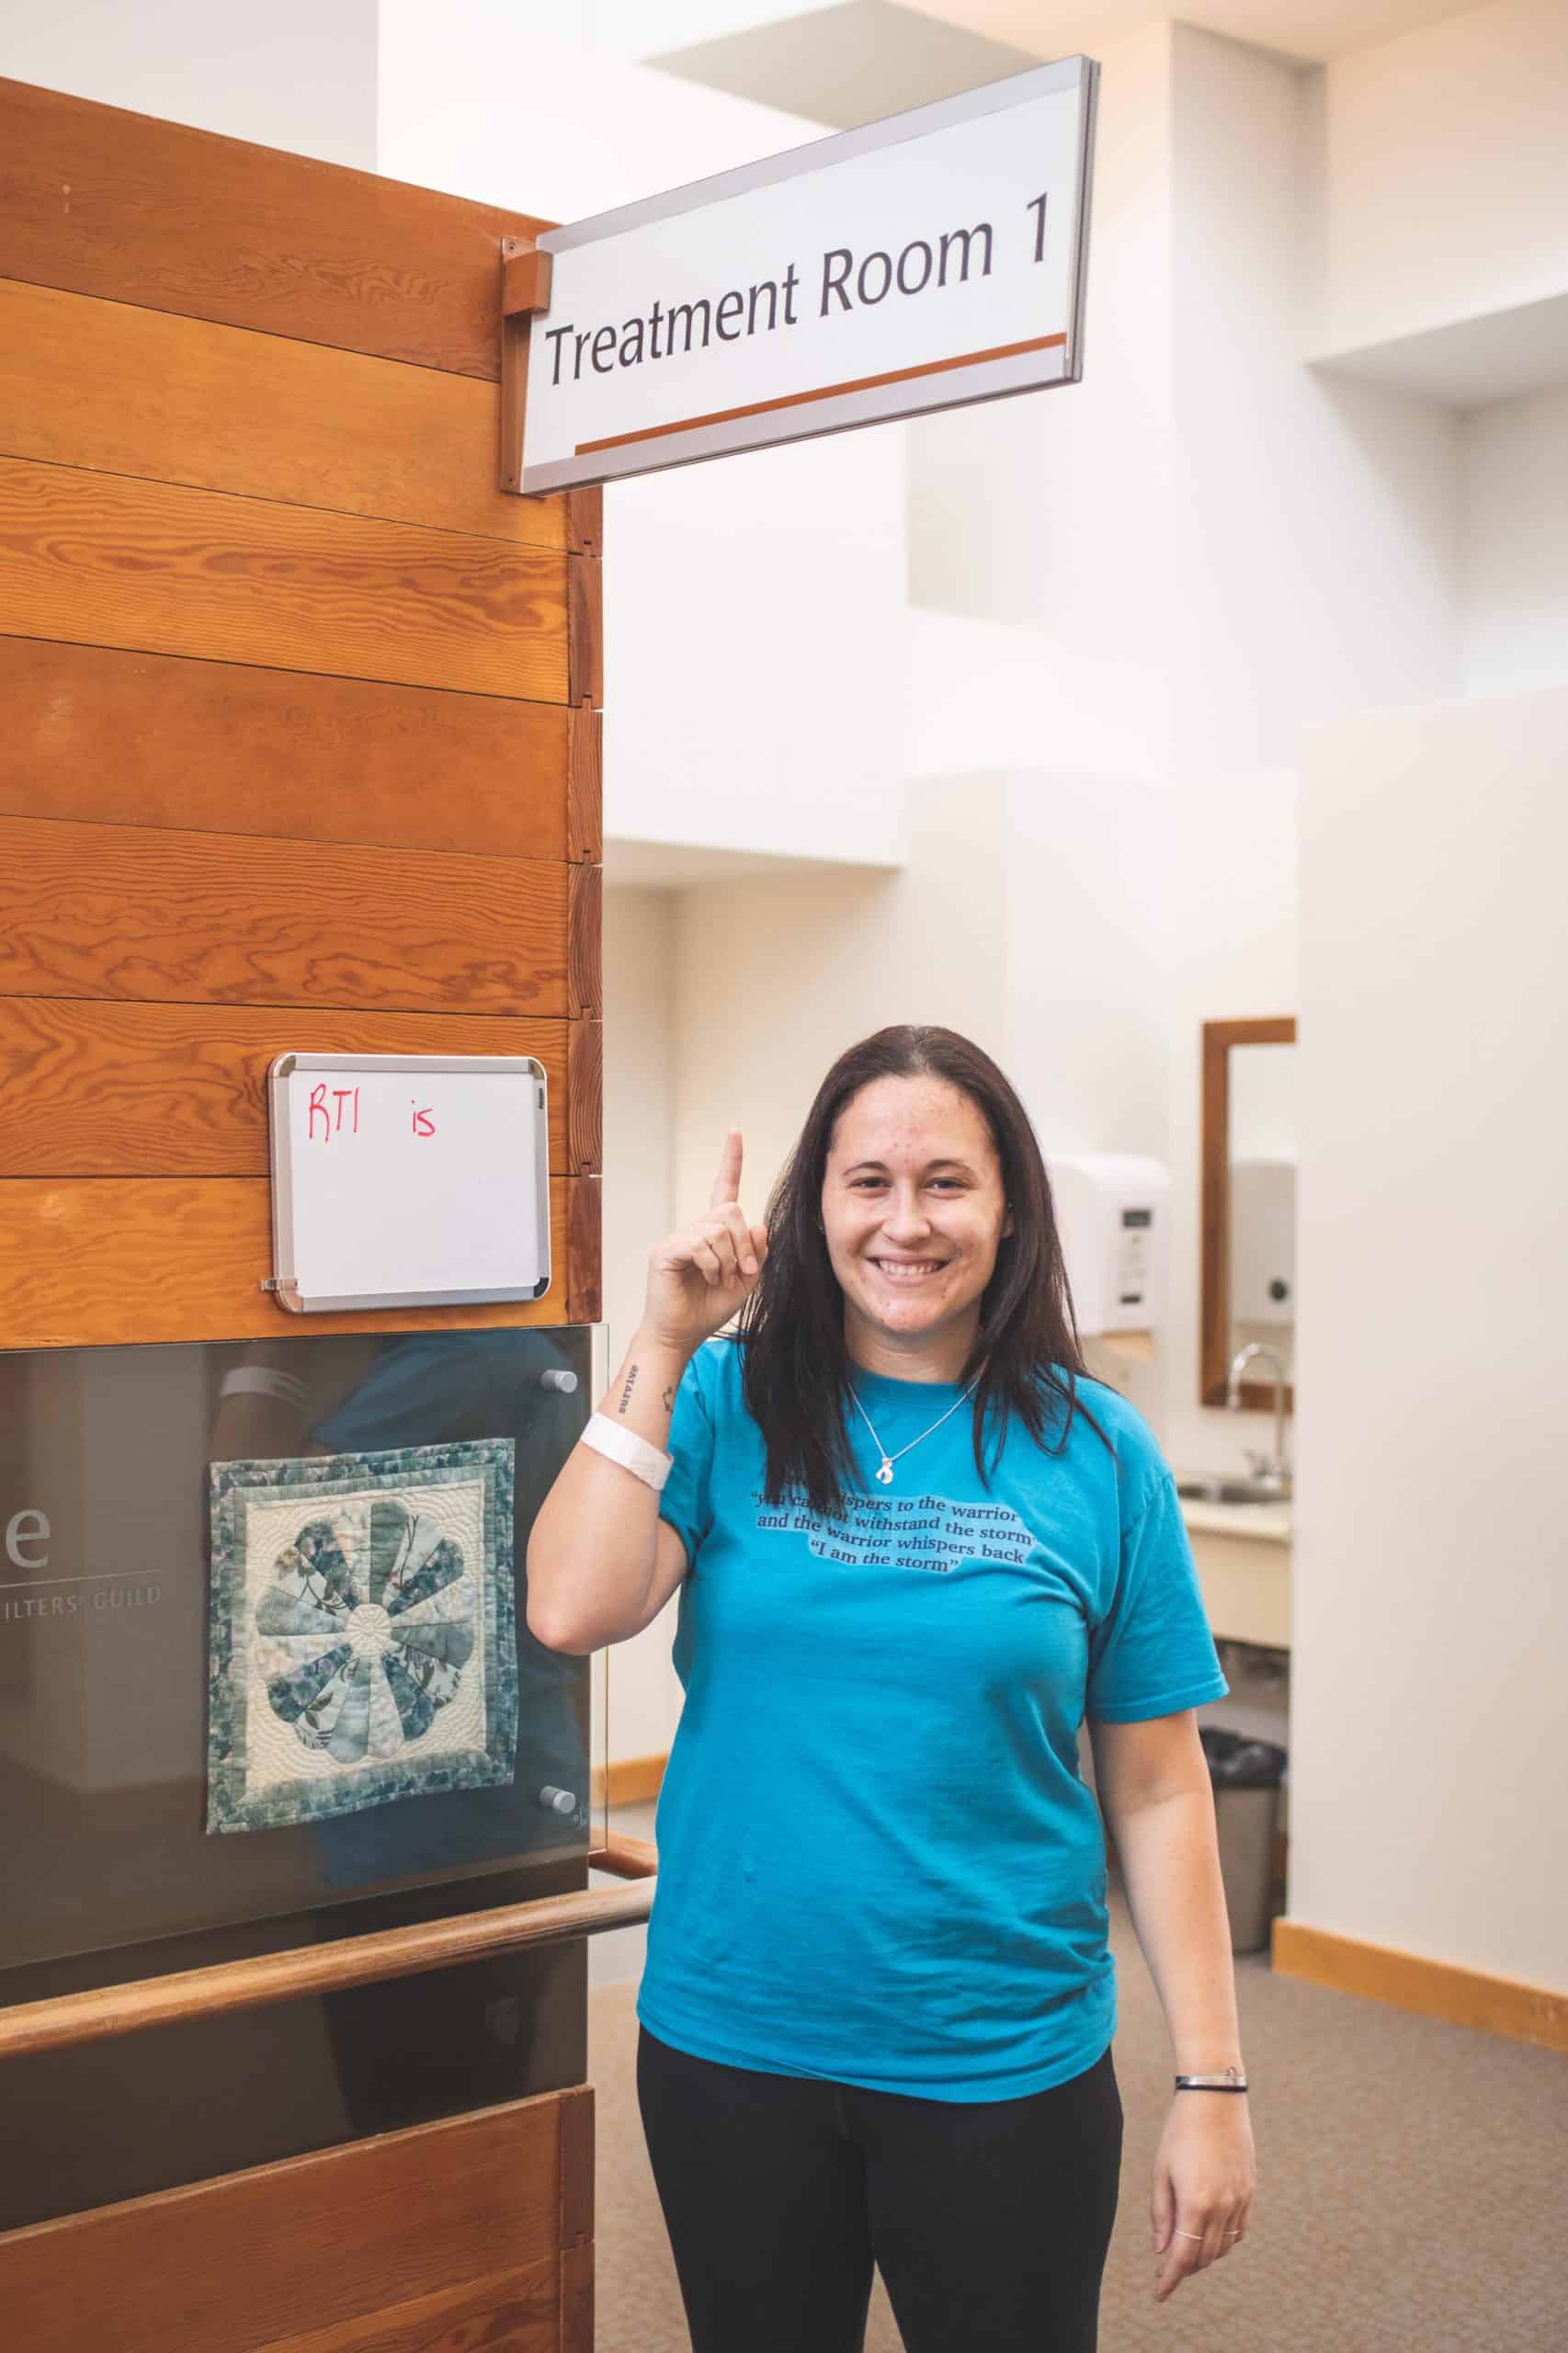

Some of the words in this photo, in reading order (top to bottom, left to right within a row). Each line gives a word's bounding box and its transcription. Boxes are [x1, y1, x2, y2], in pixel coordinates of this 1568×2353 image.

[545, 263, 801, 386] Treatment
[820, 222, 994, 317] Room
[1026, 191, 1049, 264] 1
[308, 1083, 360, 1142] RTI
[411, 1099, 436, 1137] is
[897, 1500, 914, 1512] to
[919, 1495, 946, 1511] the
[757, 1513, 788, 1528] and
[793, 1516, 822, 1532] the
[827, 1527, 892, 1548] warrior
[897, 1536, 975, 1555] whispers
[982, 1544, 1025, 1563] back
[855, 1517, 940, 1531] withstand
[945, 1521, 974, 1537] the
[979, 1528, 1033, 1546] storm
[830, 1549, 857, 1564] am
[863, 1552, 890, 1565] the
[895, 1556, 960, 1573] storm"
[94, 1586, 163, 1610] GUILD
